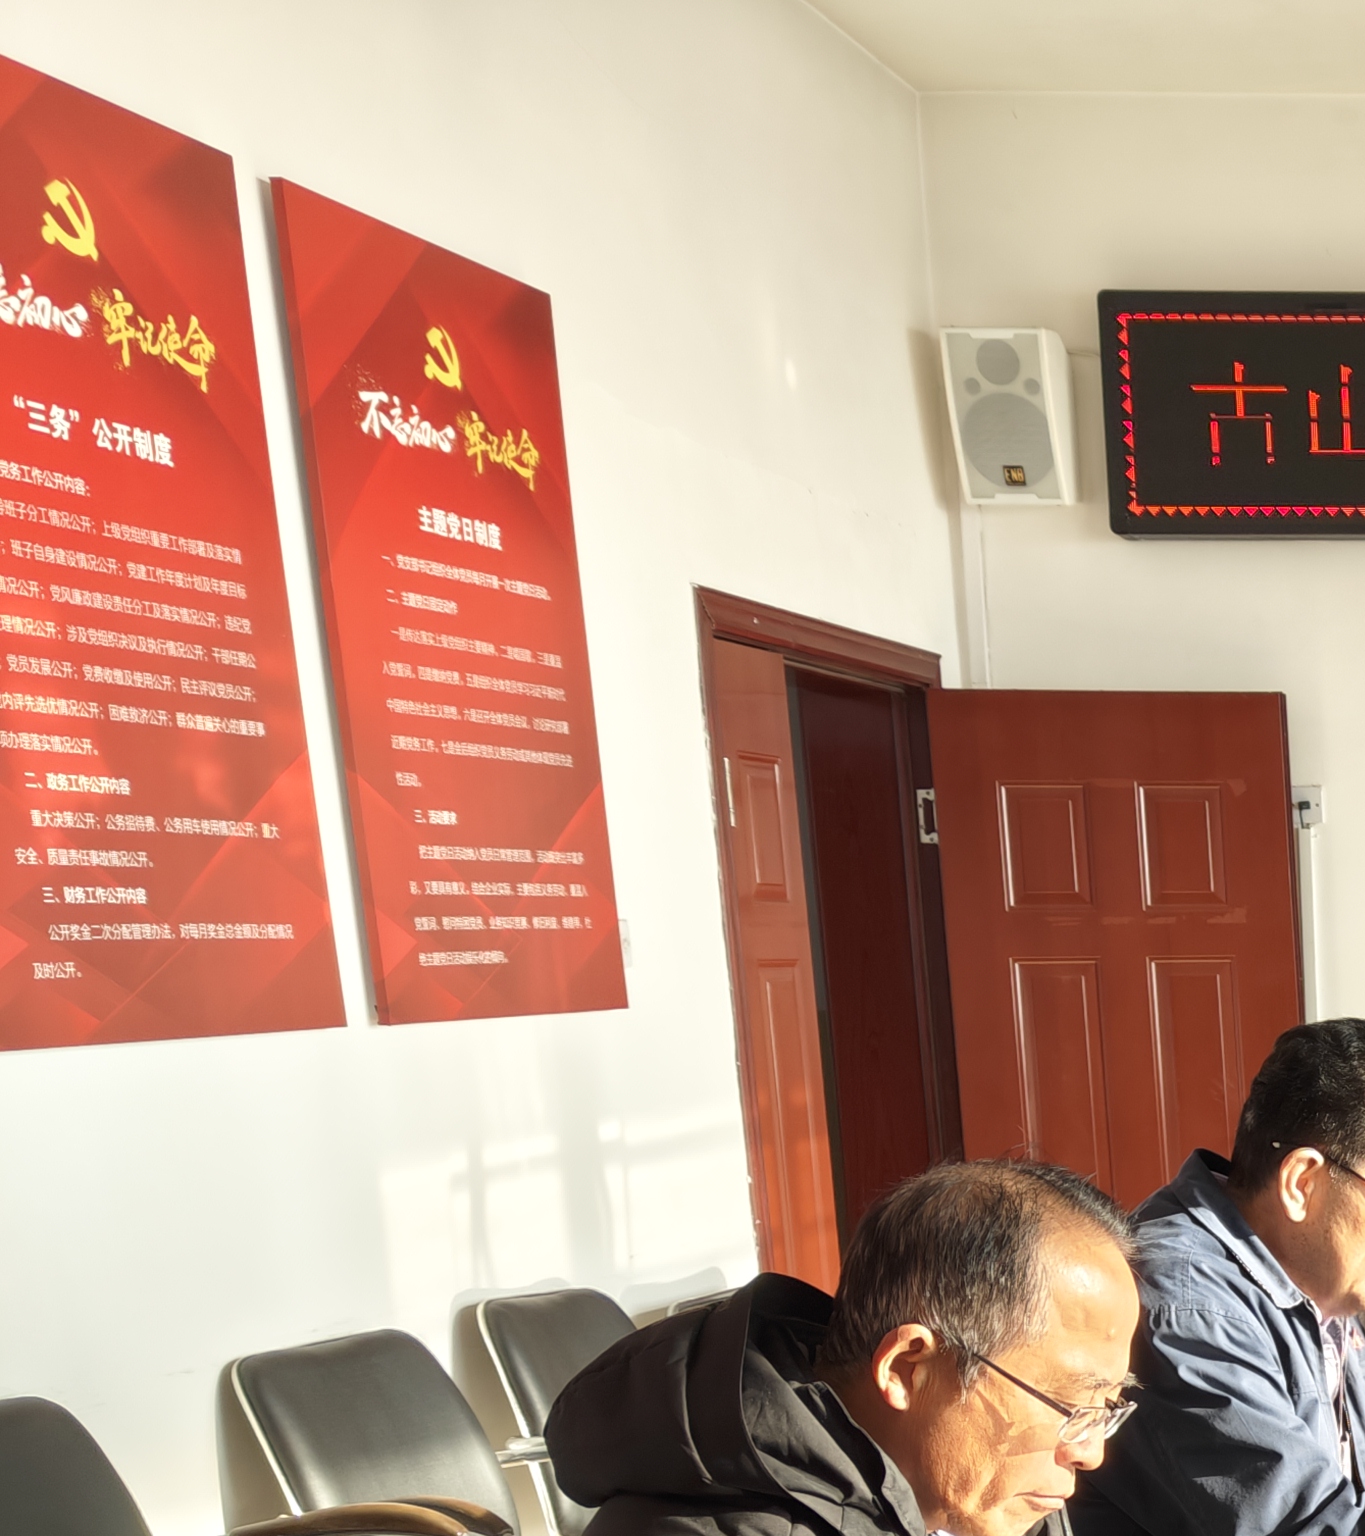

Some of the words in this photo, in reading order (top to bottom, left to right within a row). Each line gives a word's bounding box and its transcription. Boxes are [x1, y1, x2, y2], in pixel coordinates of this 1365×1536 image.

[101, 288, 216, 394] 牢记使命
[357, 390, 456, 454] 不忘初心
[463, 410, 540, 493] 牢记使命
[416, 505, 504, 552] 主题党日制度
[24, 772, 132, 796] 二、政务工作公开内容
[41, 886, 148, 905] 三、财务工作公开内容
[32, 961, 83, 980] 及时公开。
